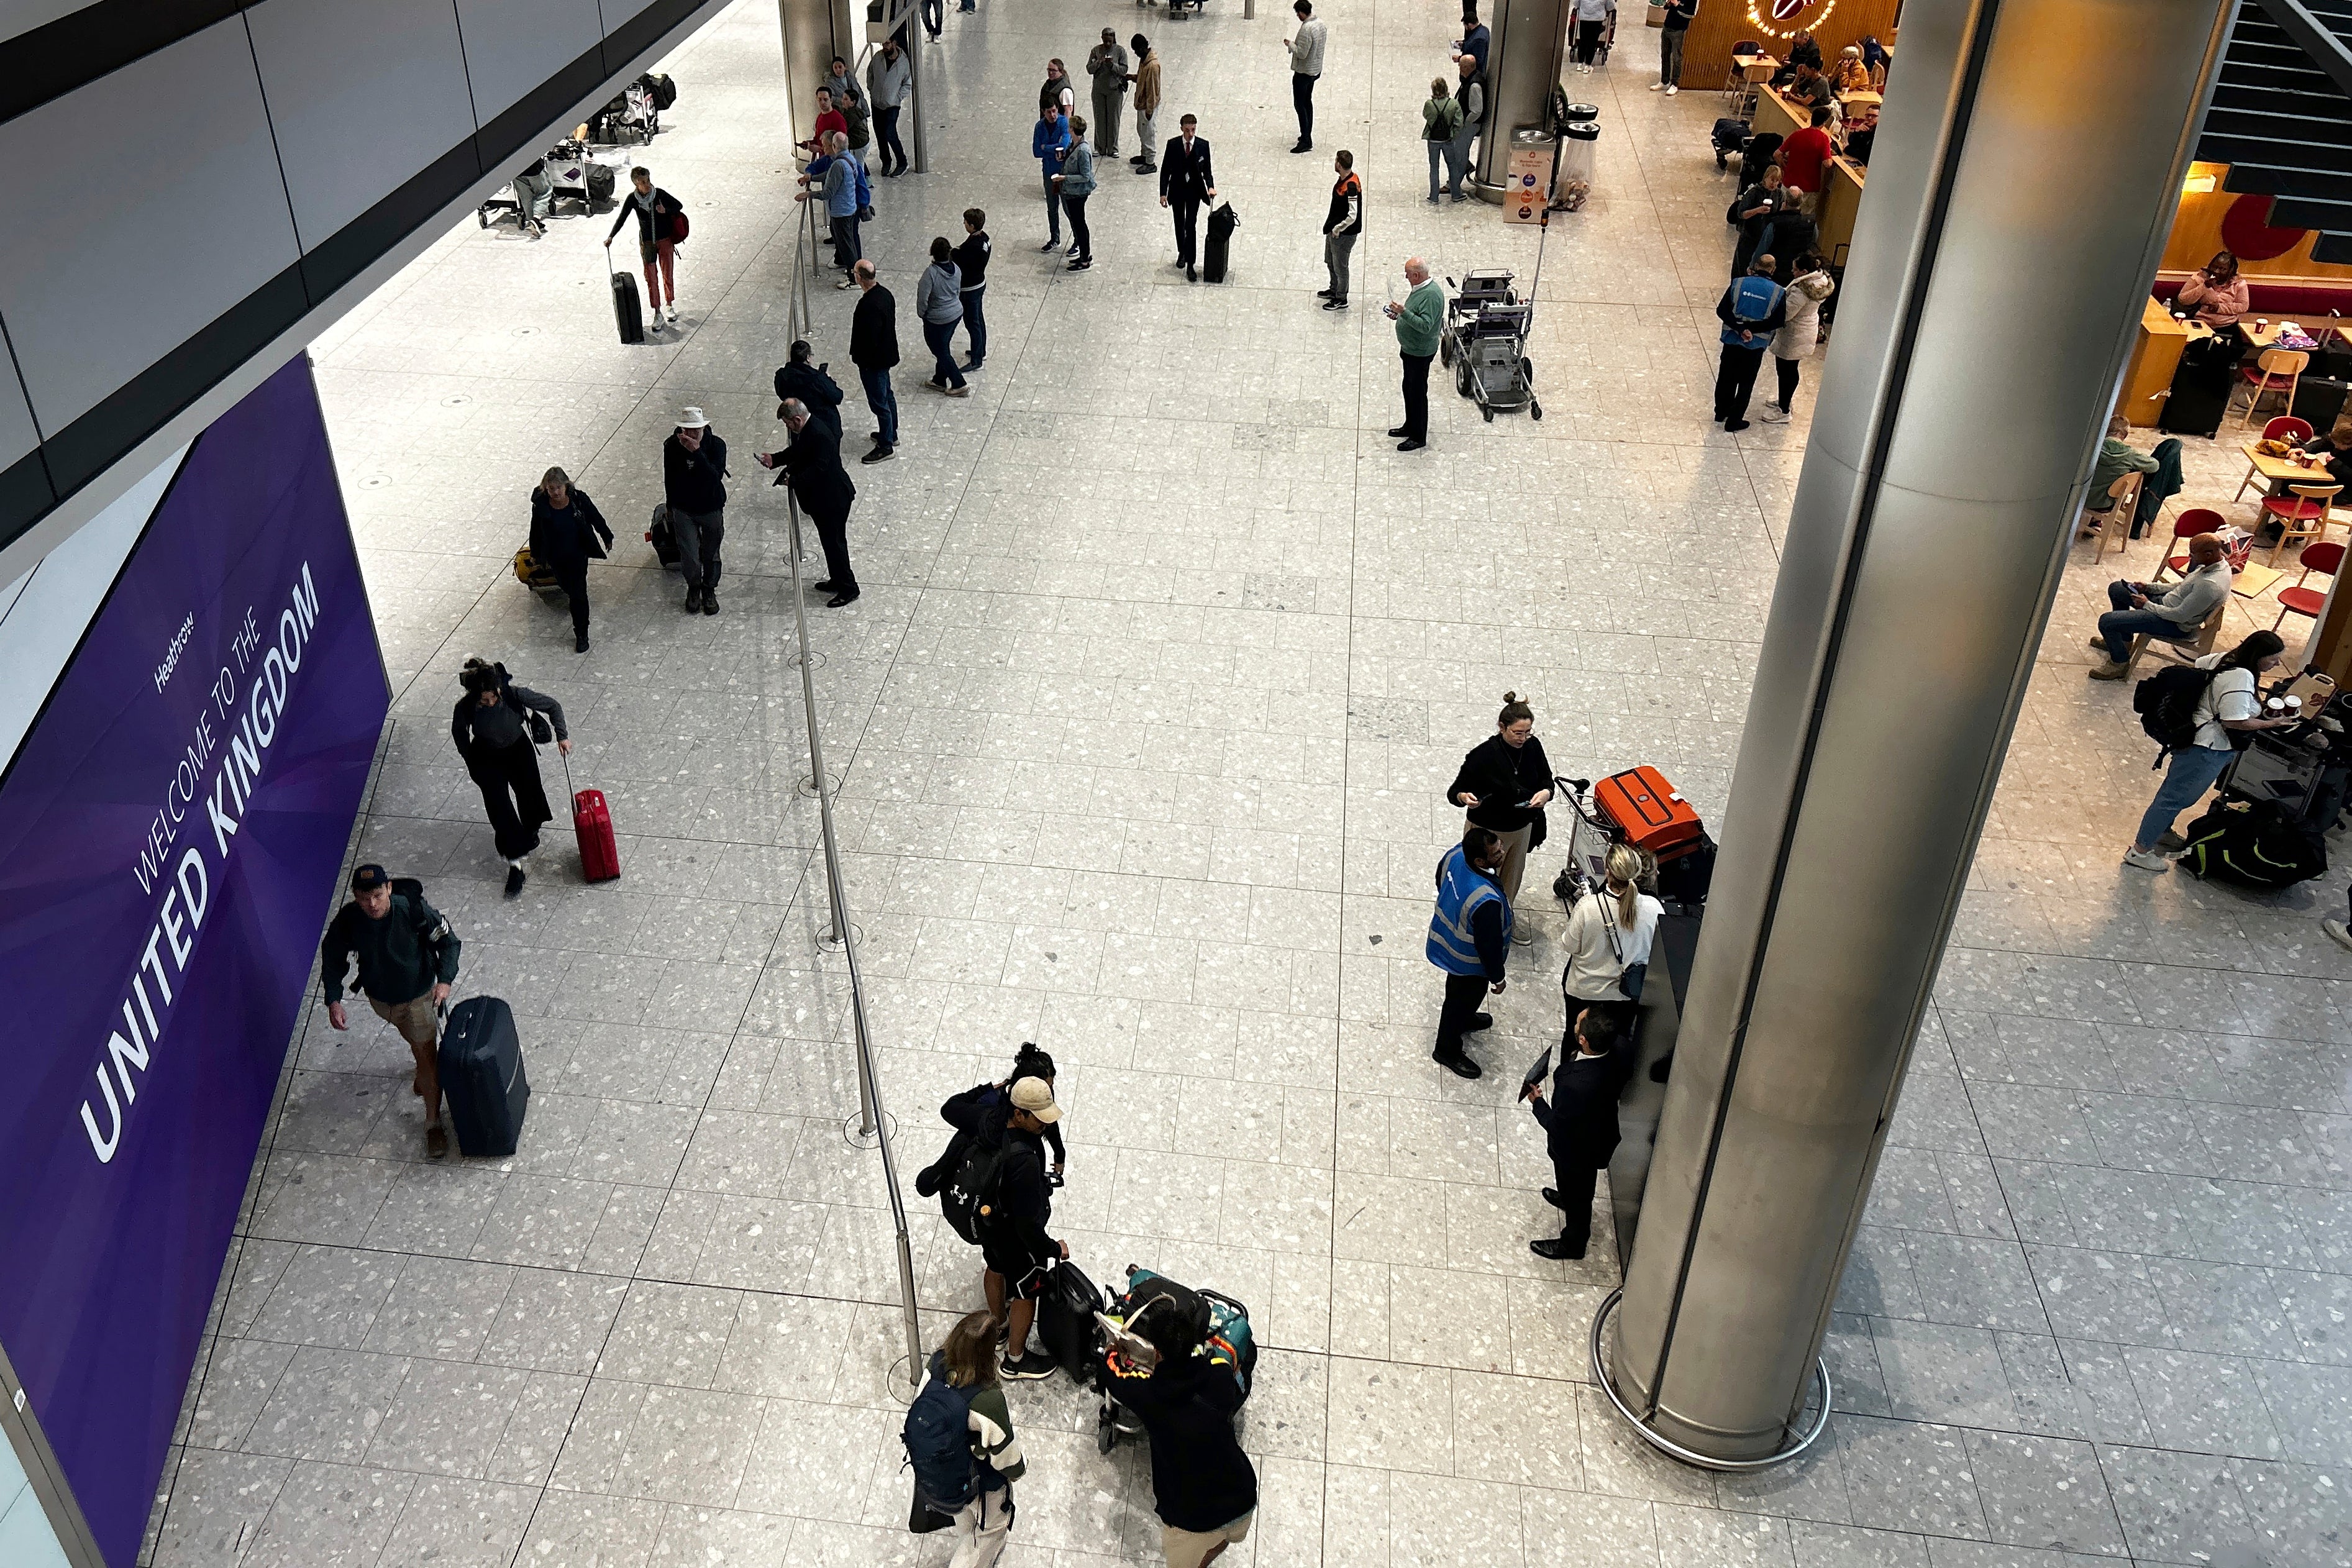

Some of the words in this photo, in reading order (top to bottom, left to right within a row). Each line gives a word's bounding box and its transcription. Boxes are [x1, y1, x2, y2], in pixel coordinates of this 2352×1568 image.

[134, 709, 215, 895] WELCOME
[211, 667, 234, 721] TO
[232, 606, 260, 674] THE
[154, 611, 194, 694] Heathrow
[81, 848, 207, 1164] UNITED
[207, 560, 319, 859] KINGDOM
